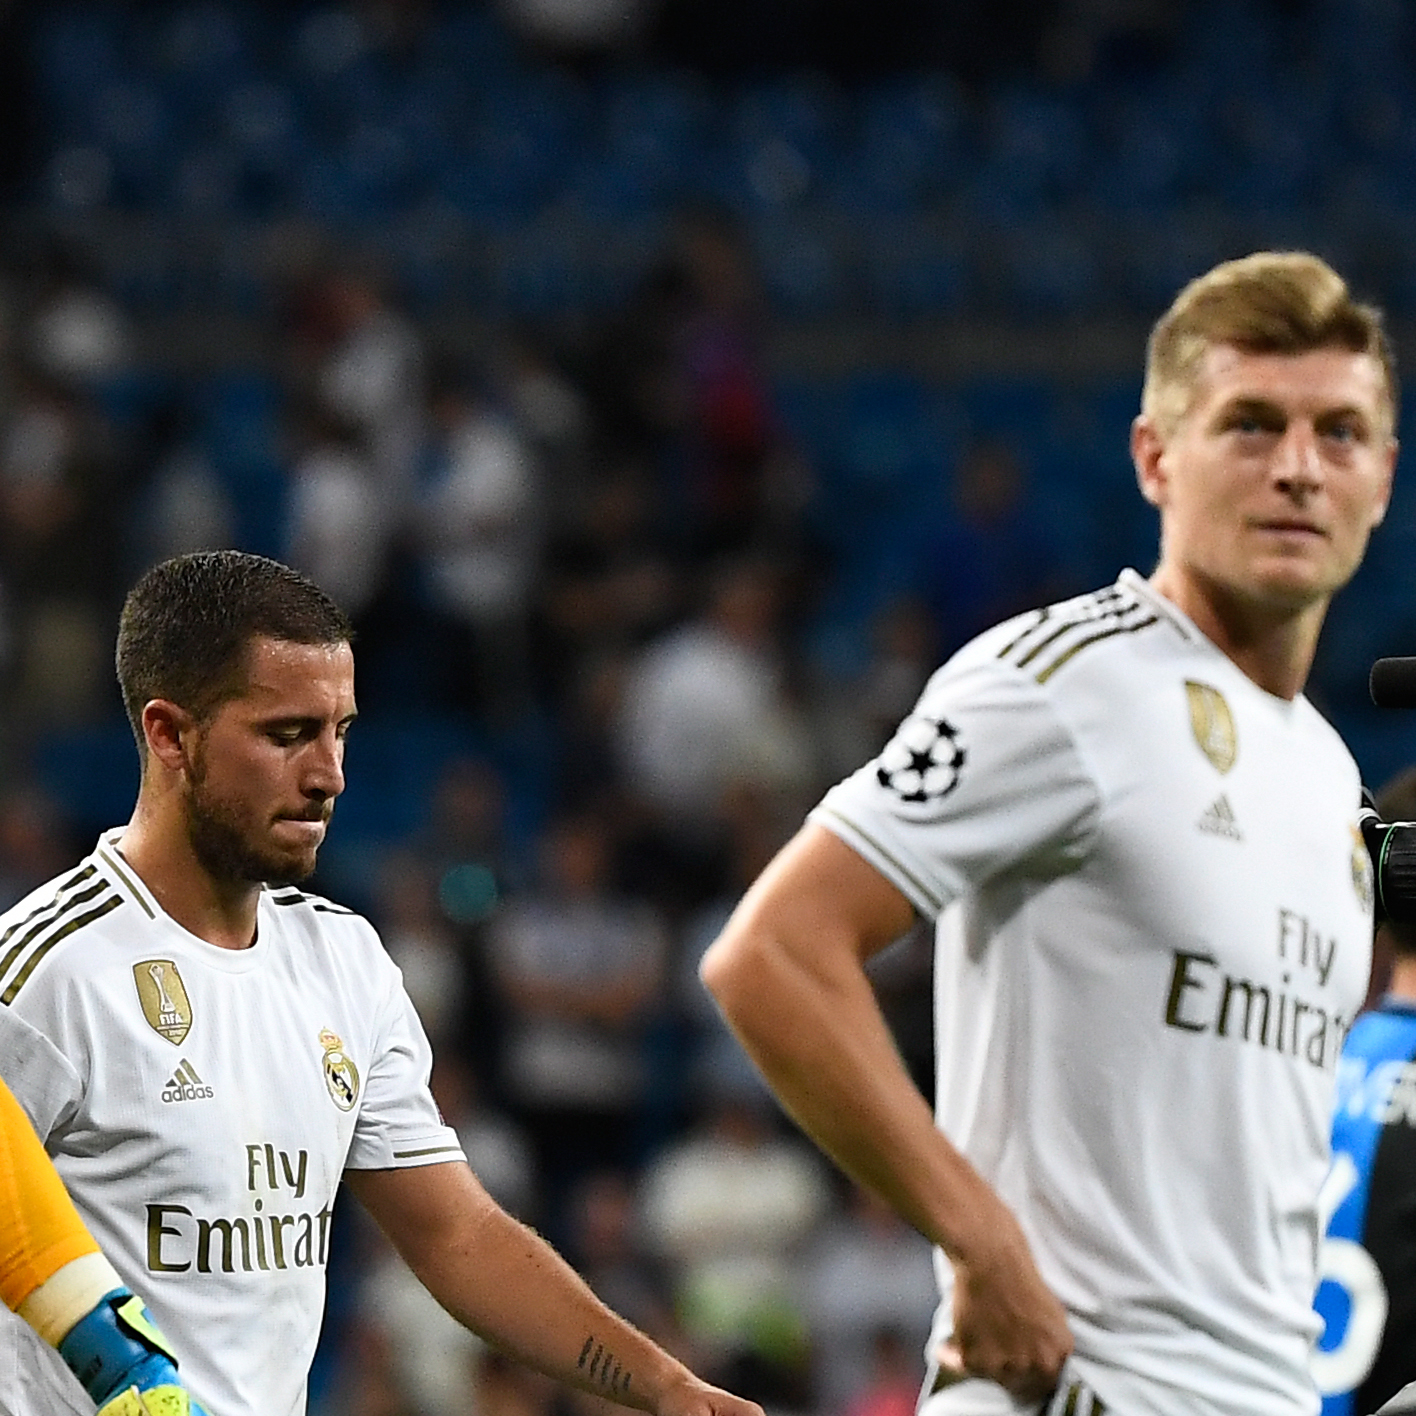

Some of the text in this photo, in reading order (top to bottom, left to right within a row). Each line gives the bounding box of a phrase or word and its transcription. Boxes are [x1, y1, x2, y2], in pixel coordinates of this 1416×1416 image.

[1277, 907, 1337, 987] Fly
[158, 1012, 185, 1025] FIFA
[161, 1085, 214, 1103] adidas
[245, 1143, 308, 1199] Fly
[145, 1198, 333, 1274] Emirat
